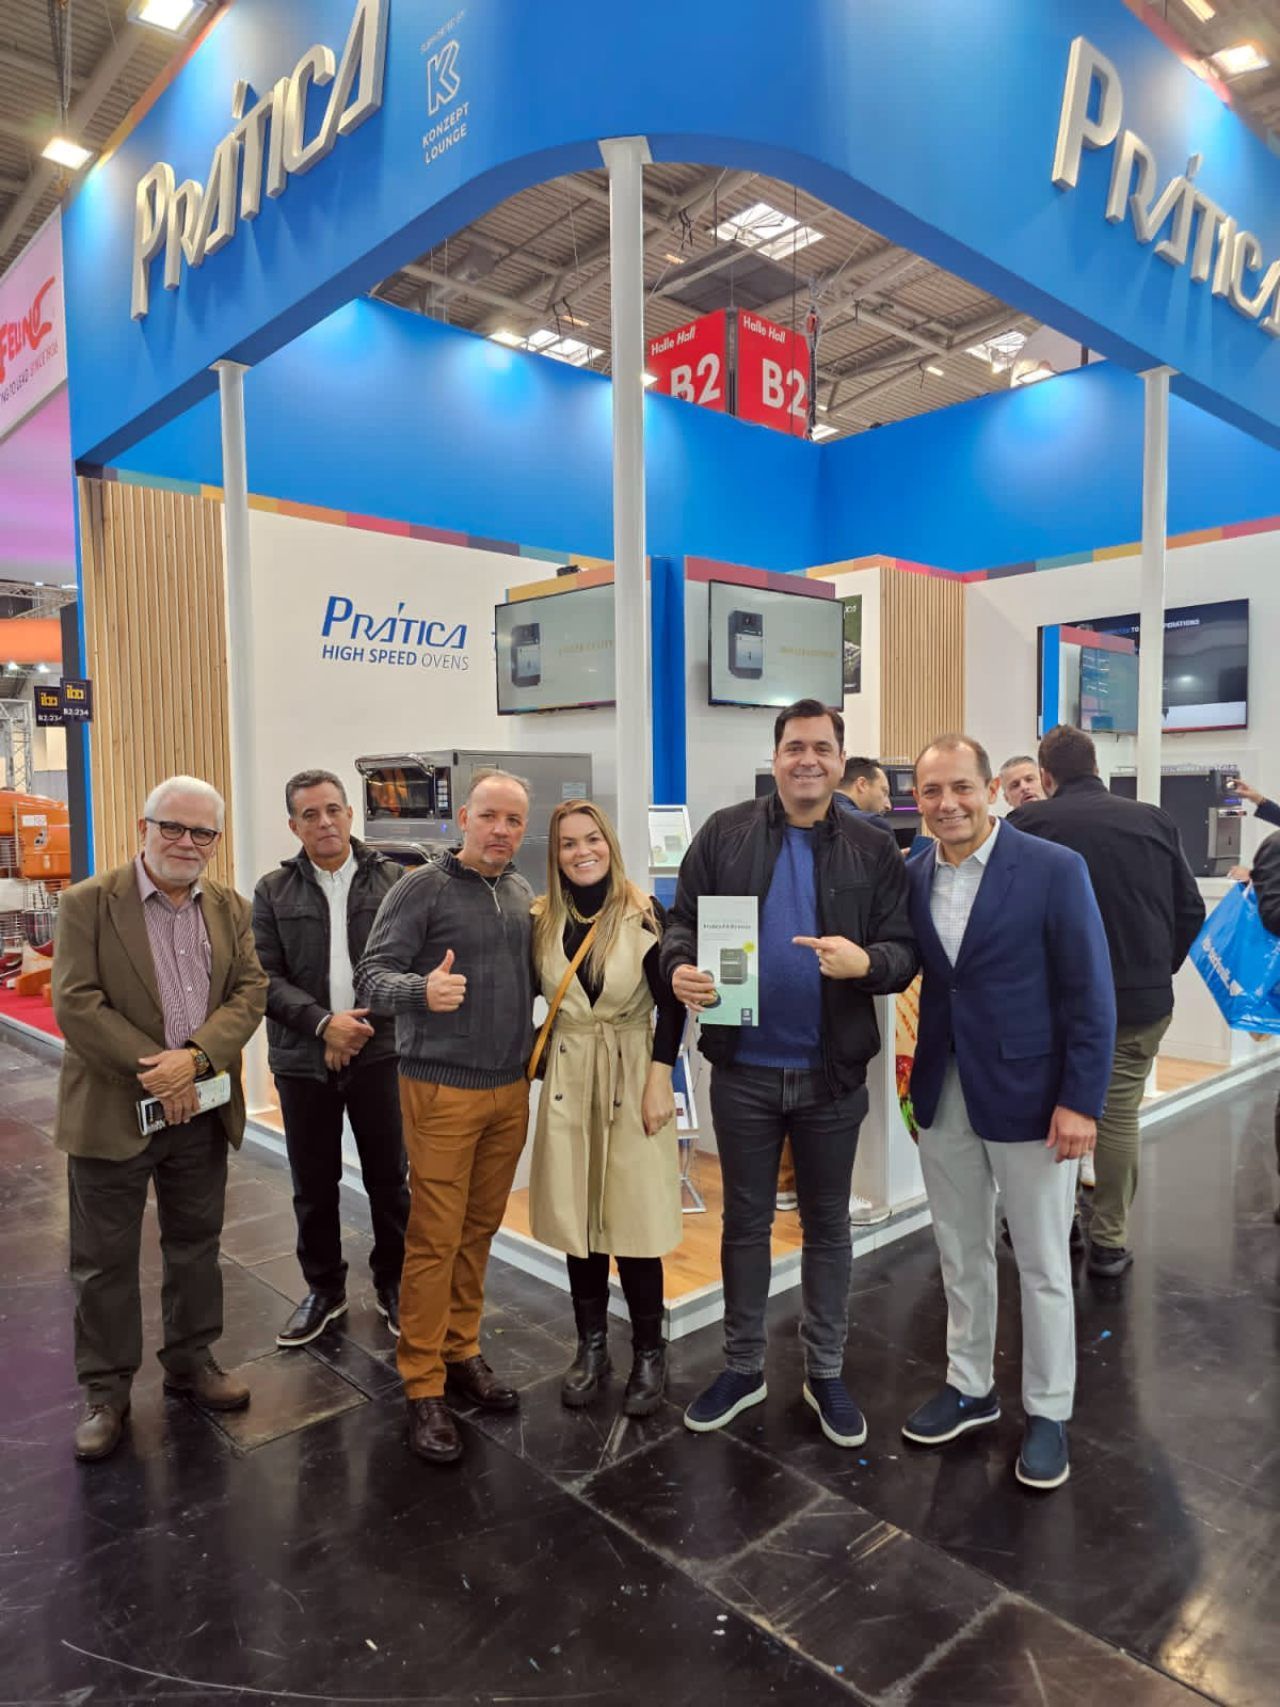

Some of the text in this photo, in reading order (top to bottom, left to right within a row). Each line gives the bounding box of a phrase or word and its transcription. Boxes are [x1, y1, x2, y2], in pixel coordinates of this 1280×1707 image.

[422, 102, 469, 148] KONZEPT
[425, 123, 467, 164] LOUNGE
[651, 325, 696, 356] Halle Hall
[743, 316, 785, 343] Halle Hall
[671, 353, 720, 405] B2
[762, 358, 806, 418] B2
[322, 644, 470, 671] HIGH SPEED OVENS
